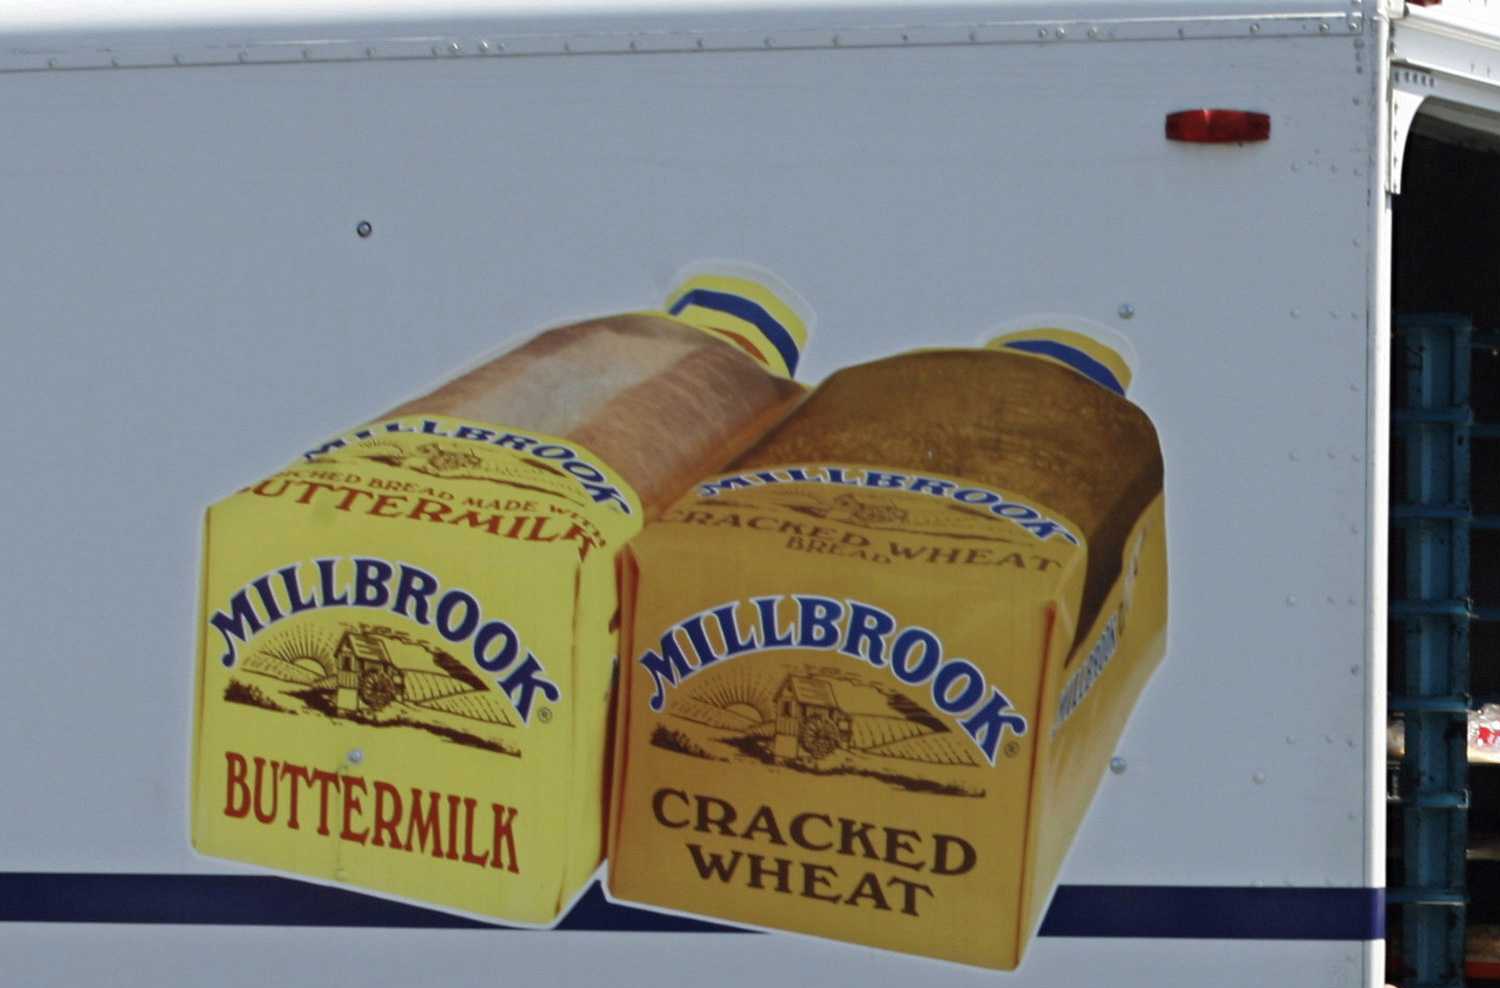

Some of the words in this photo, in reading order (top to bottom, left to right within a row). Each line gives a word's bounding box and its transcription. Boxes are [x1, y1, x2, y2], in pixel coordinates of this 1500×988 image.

[237, 477, 598, 563] UTTERMILK
[368, 477, 455, 501] BREAD
[462, 497, 537, 512] MADE
[785, 535, 892, 565] BREAD
[888, 541, 1062, 573] WHEAT
[209, 556, 561, 725] MILLBROOK
[638, 594, 1028, 768] MILLBROOK
[223, 750, 521, 875] BUTTERMILK
[650, 786, 978, 876] CRACKED
[685, 842, 935, 918] WHEAT
